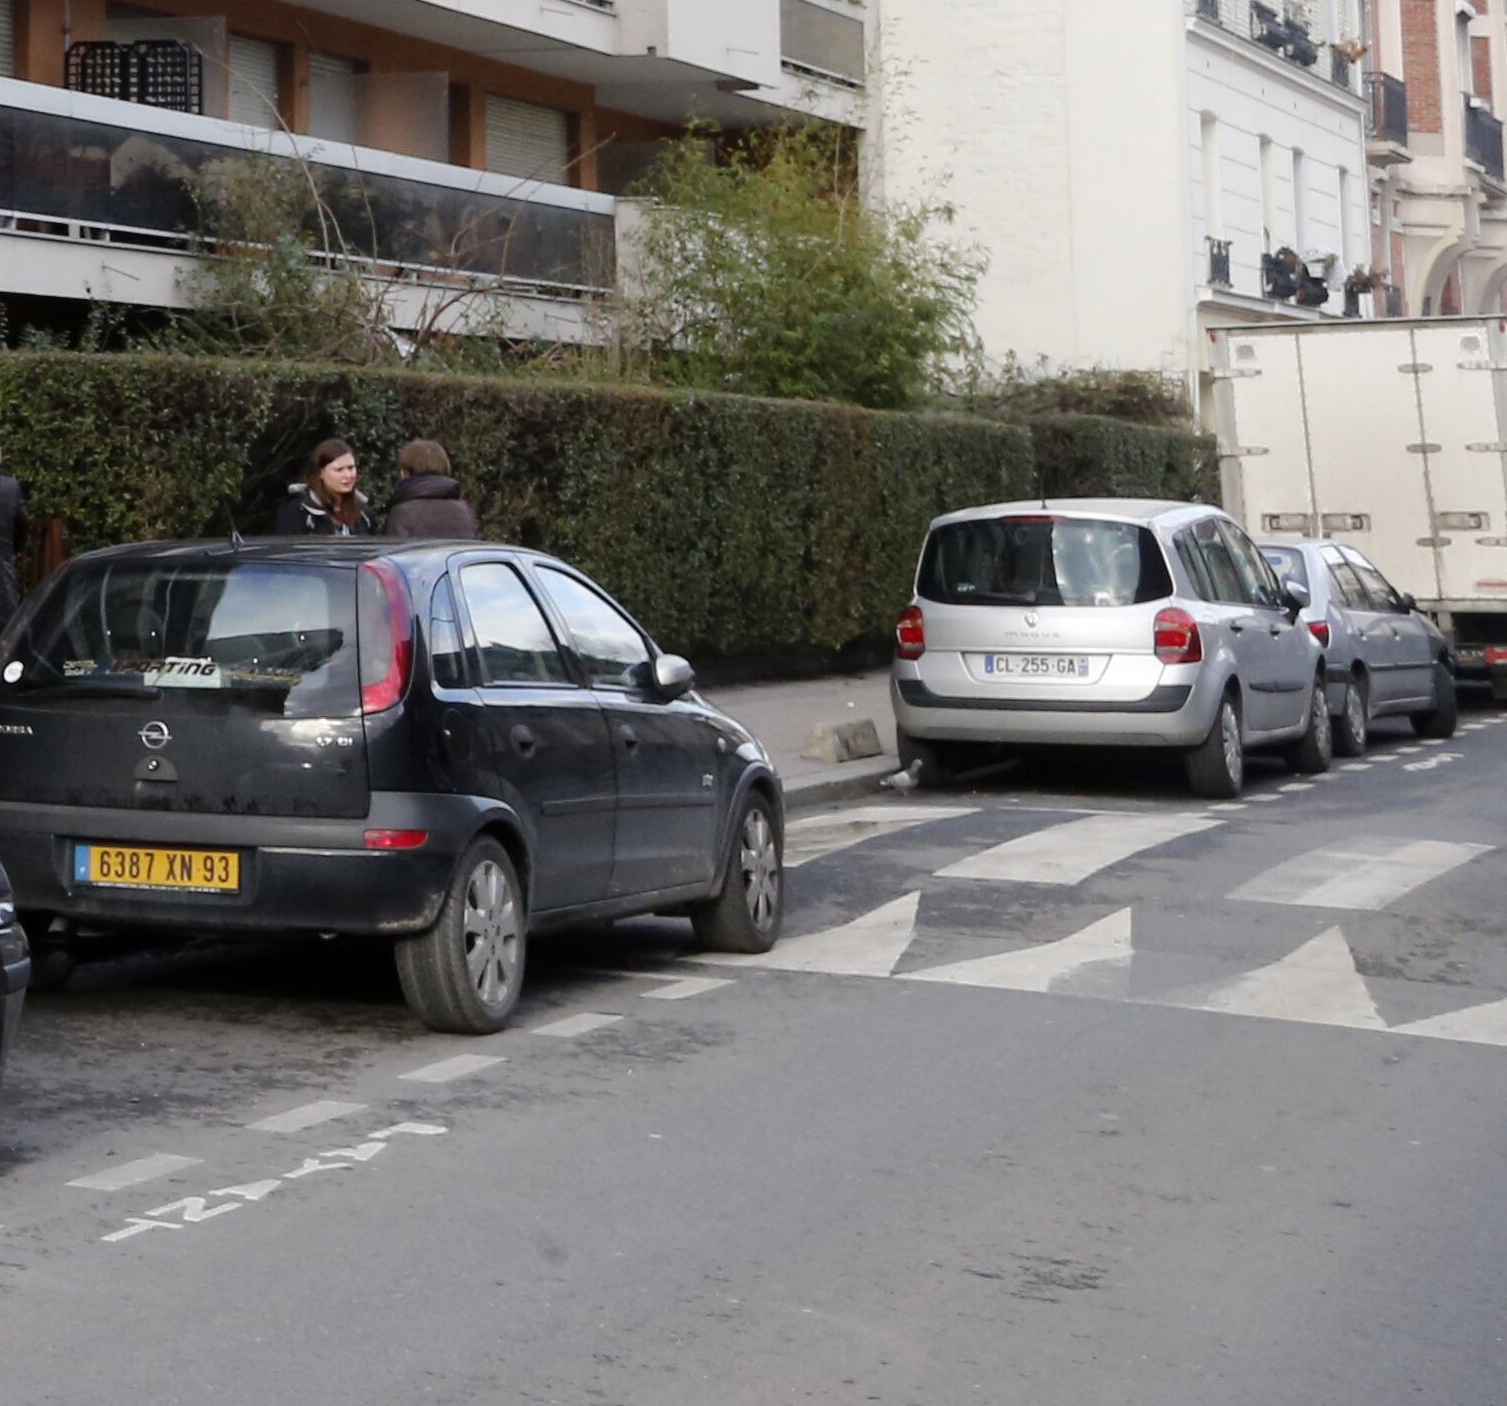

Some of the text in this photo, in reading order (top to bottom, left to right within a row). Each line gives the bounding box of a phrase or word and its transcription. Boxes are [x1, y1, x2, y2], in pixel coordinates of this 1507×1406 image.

[100, 850, 229, 883] 6387 XN 93
[101, 1122, 448, 1242] PAYANT
